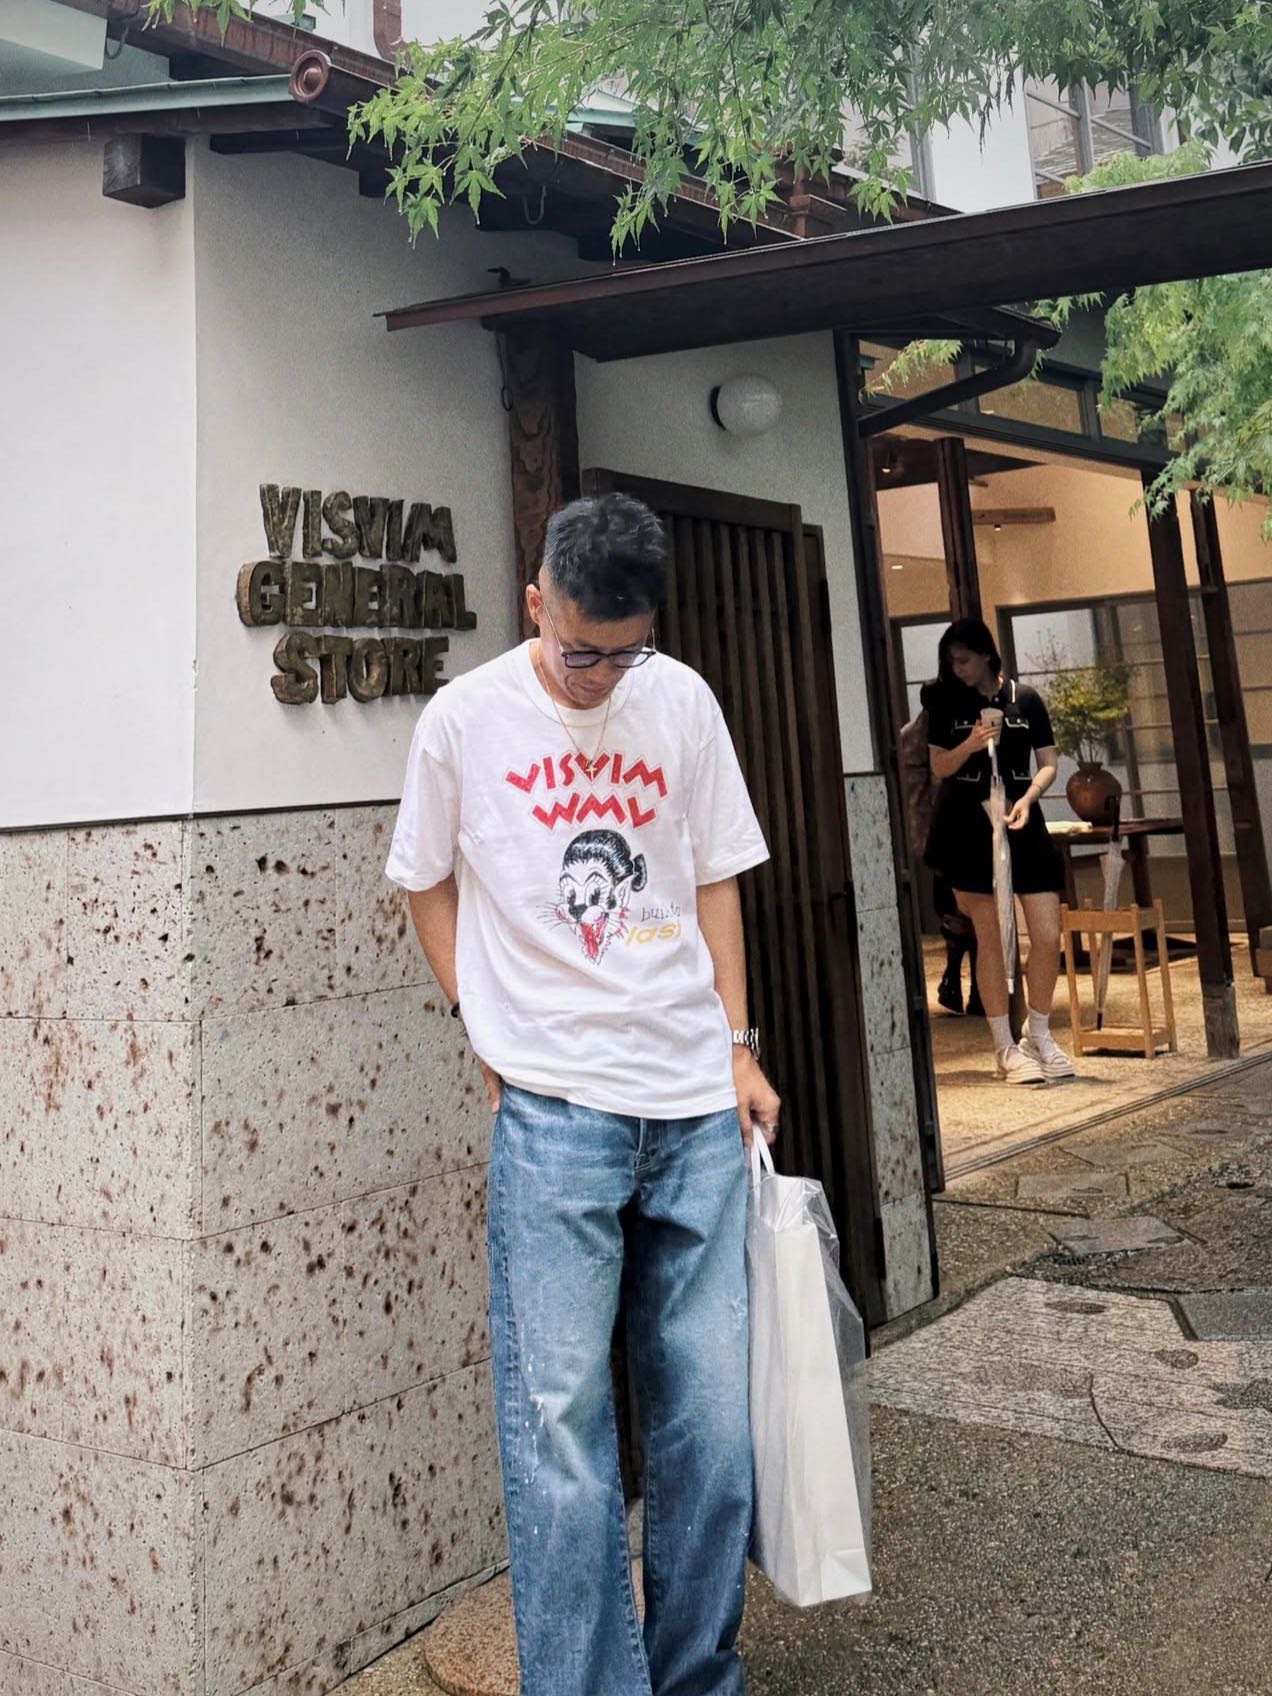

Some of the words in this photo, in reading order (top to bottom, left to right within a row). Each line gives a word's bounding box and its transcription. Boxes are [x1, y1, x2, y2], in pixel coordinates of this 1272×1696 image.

[259, 484, 457, 562] VISVIM
[236, 561, 477, 630] GENERAL
[270, 631, 449, 704] STORE
[505, 752, 668, 797] VISVIM
[531, 792, 657, 831] WML
